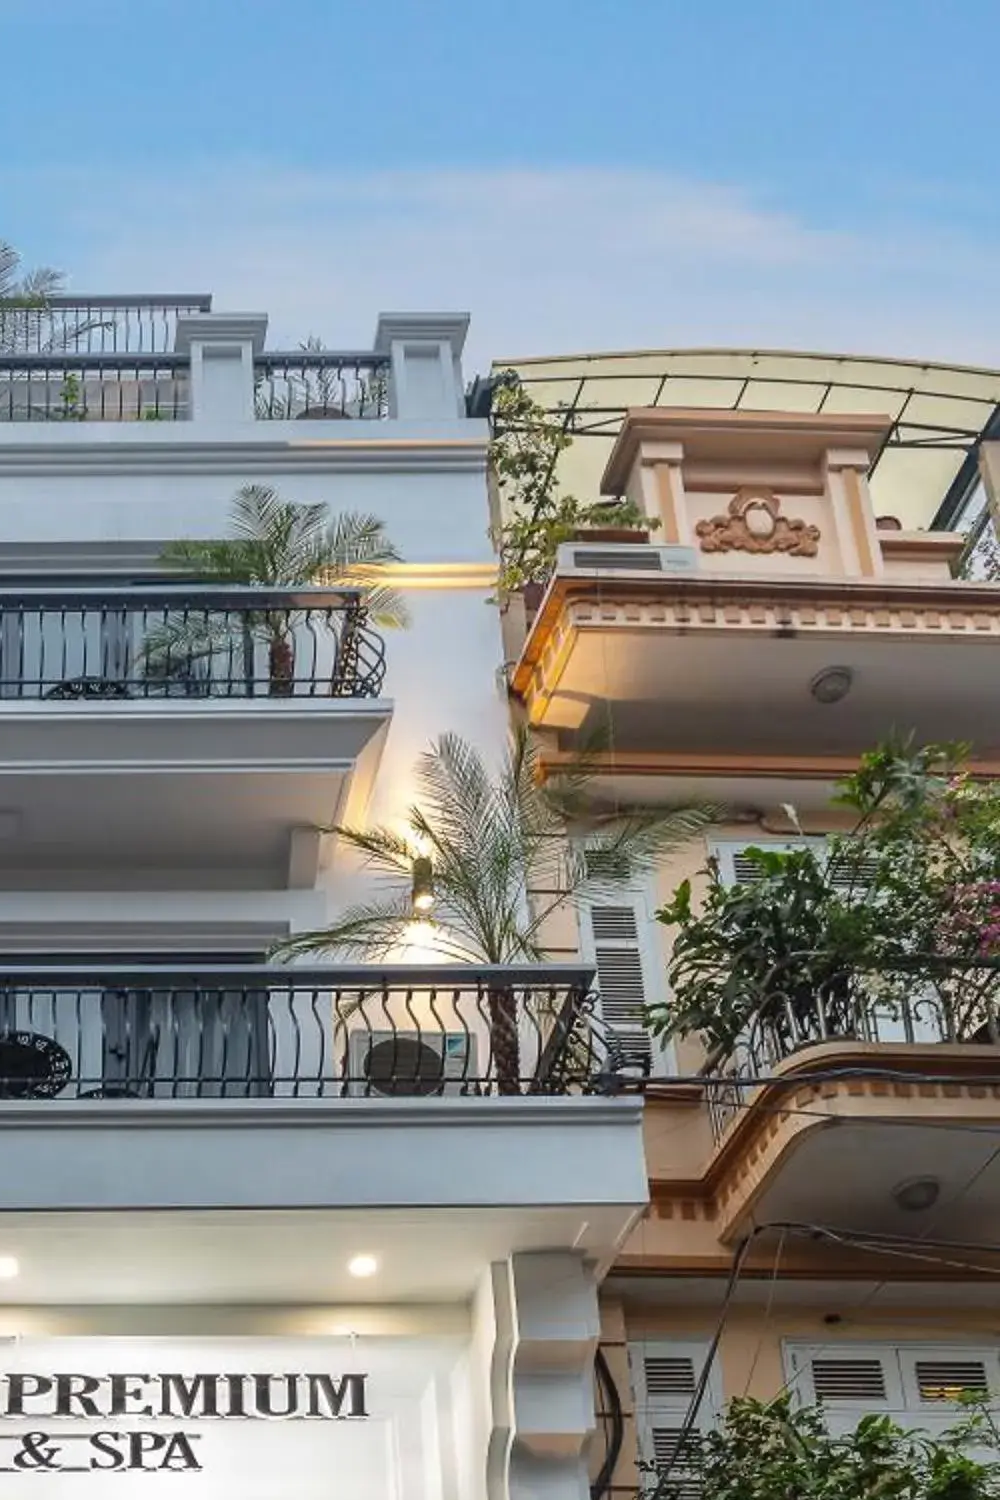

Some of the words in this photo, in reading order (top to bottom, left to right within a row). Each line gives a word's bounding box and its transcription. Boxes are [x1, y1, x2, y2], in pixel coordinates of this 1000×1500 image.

[3, 1373, 370, 1418] PREMIUM
[13, 1431, 63, 1470] &
[89, 1431, 203, 1471] SPA
